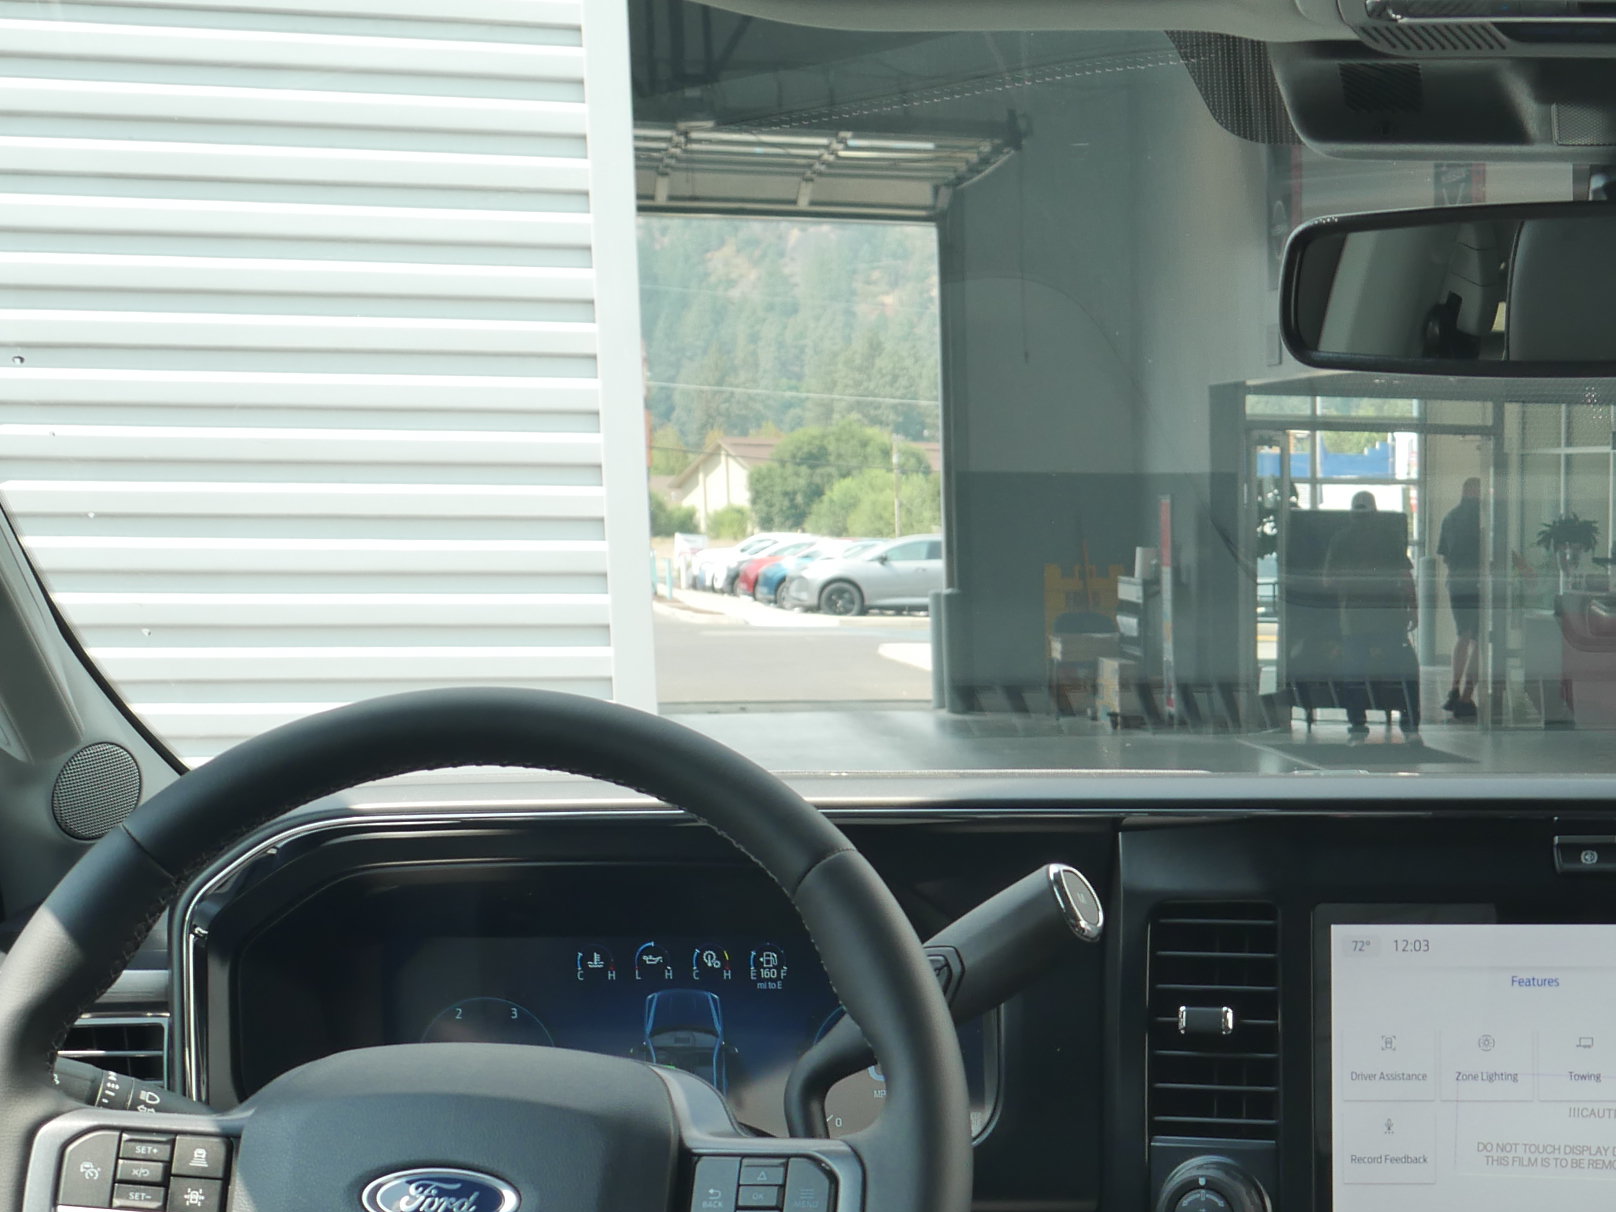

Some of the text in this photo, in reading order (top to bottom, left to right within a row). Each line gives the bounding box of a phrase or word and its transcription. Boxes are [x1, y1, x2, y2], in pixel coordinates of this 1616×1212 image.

[1393, 939, 1430, 952] 12:03
[760, 968, 777, 979] 160
[1511, 975, 1560, 987] Features
[1350, 1071, 1428, 1081] Driver Assistance
[1455, 1071, 1519, 1083] Zone Lighting
[1568, 1071, 1601, 1083] Towing
[1477, 1142, 1493, 1153] DO
[1496, 1142, 1520, 1154] NOT
[1522, 1143, 1560, 1155] TOUCH
[1564, 1144, 1609, 1157] DISPLAY
[1350, 1154, 1428, 1164] Record Feedback
[1485, 1155, 1509, 1167] THIS
[1512, 1156, 1538, 1167] FILM
[1541, 1157, 1550, 1168] IS
[1554, 1157, 1568, 1168] TO
[1572, 1158, 1585, 1169] BE
[702, 1201, 723, 1209] BACK
